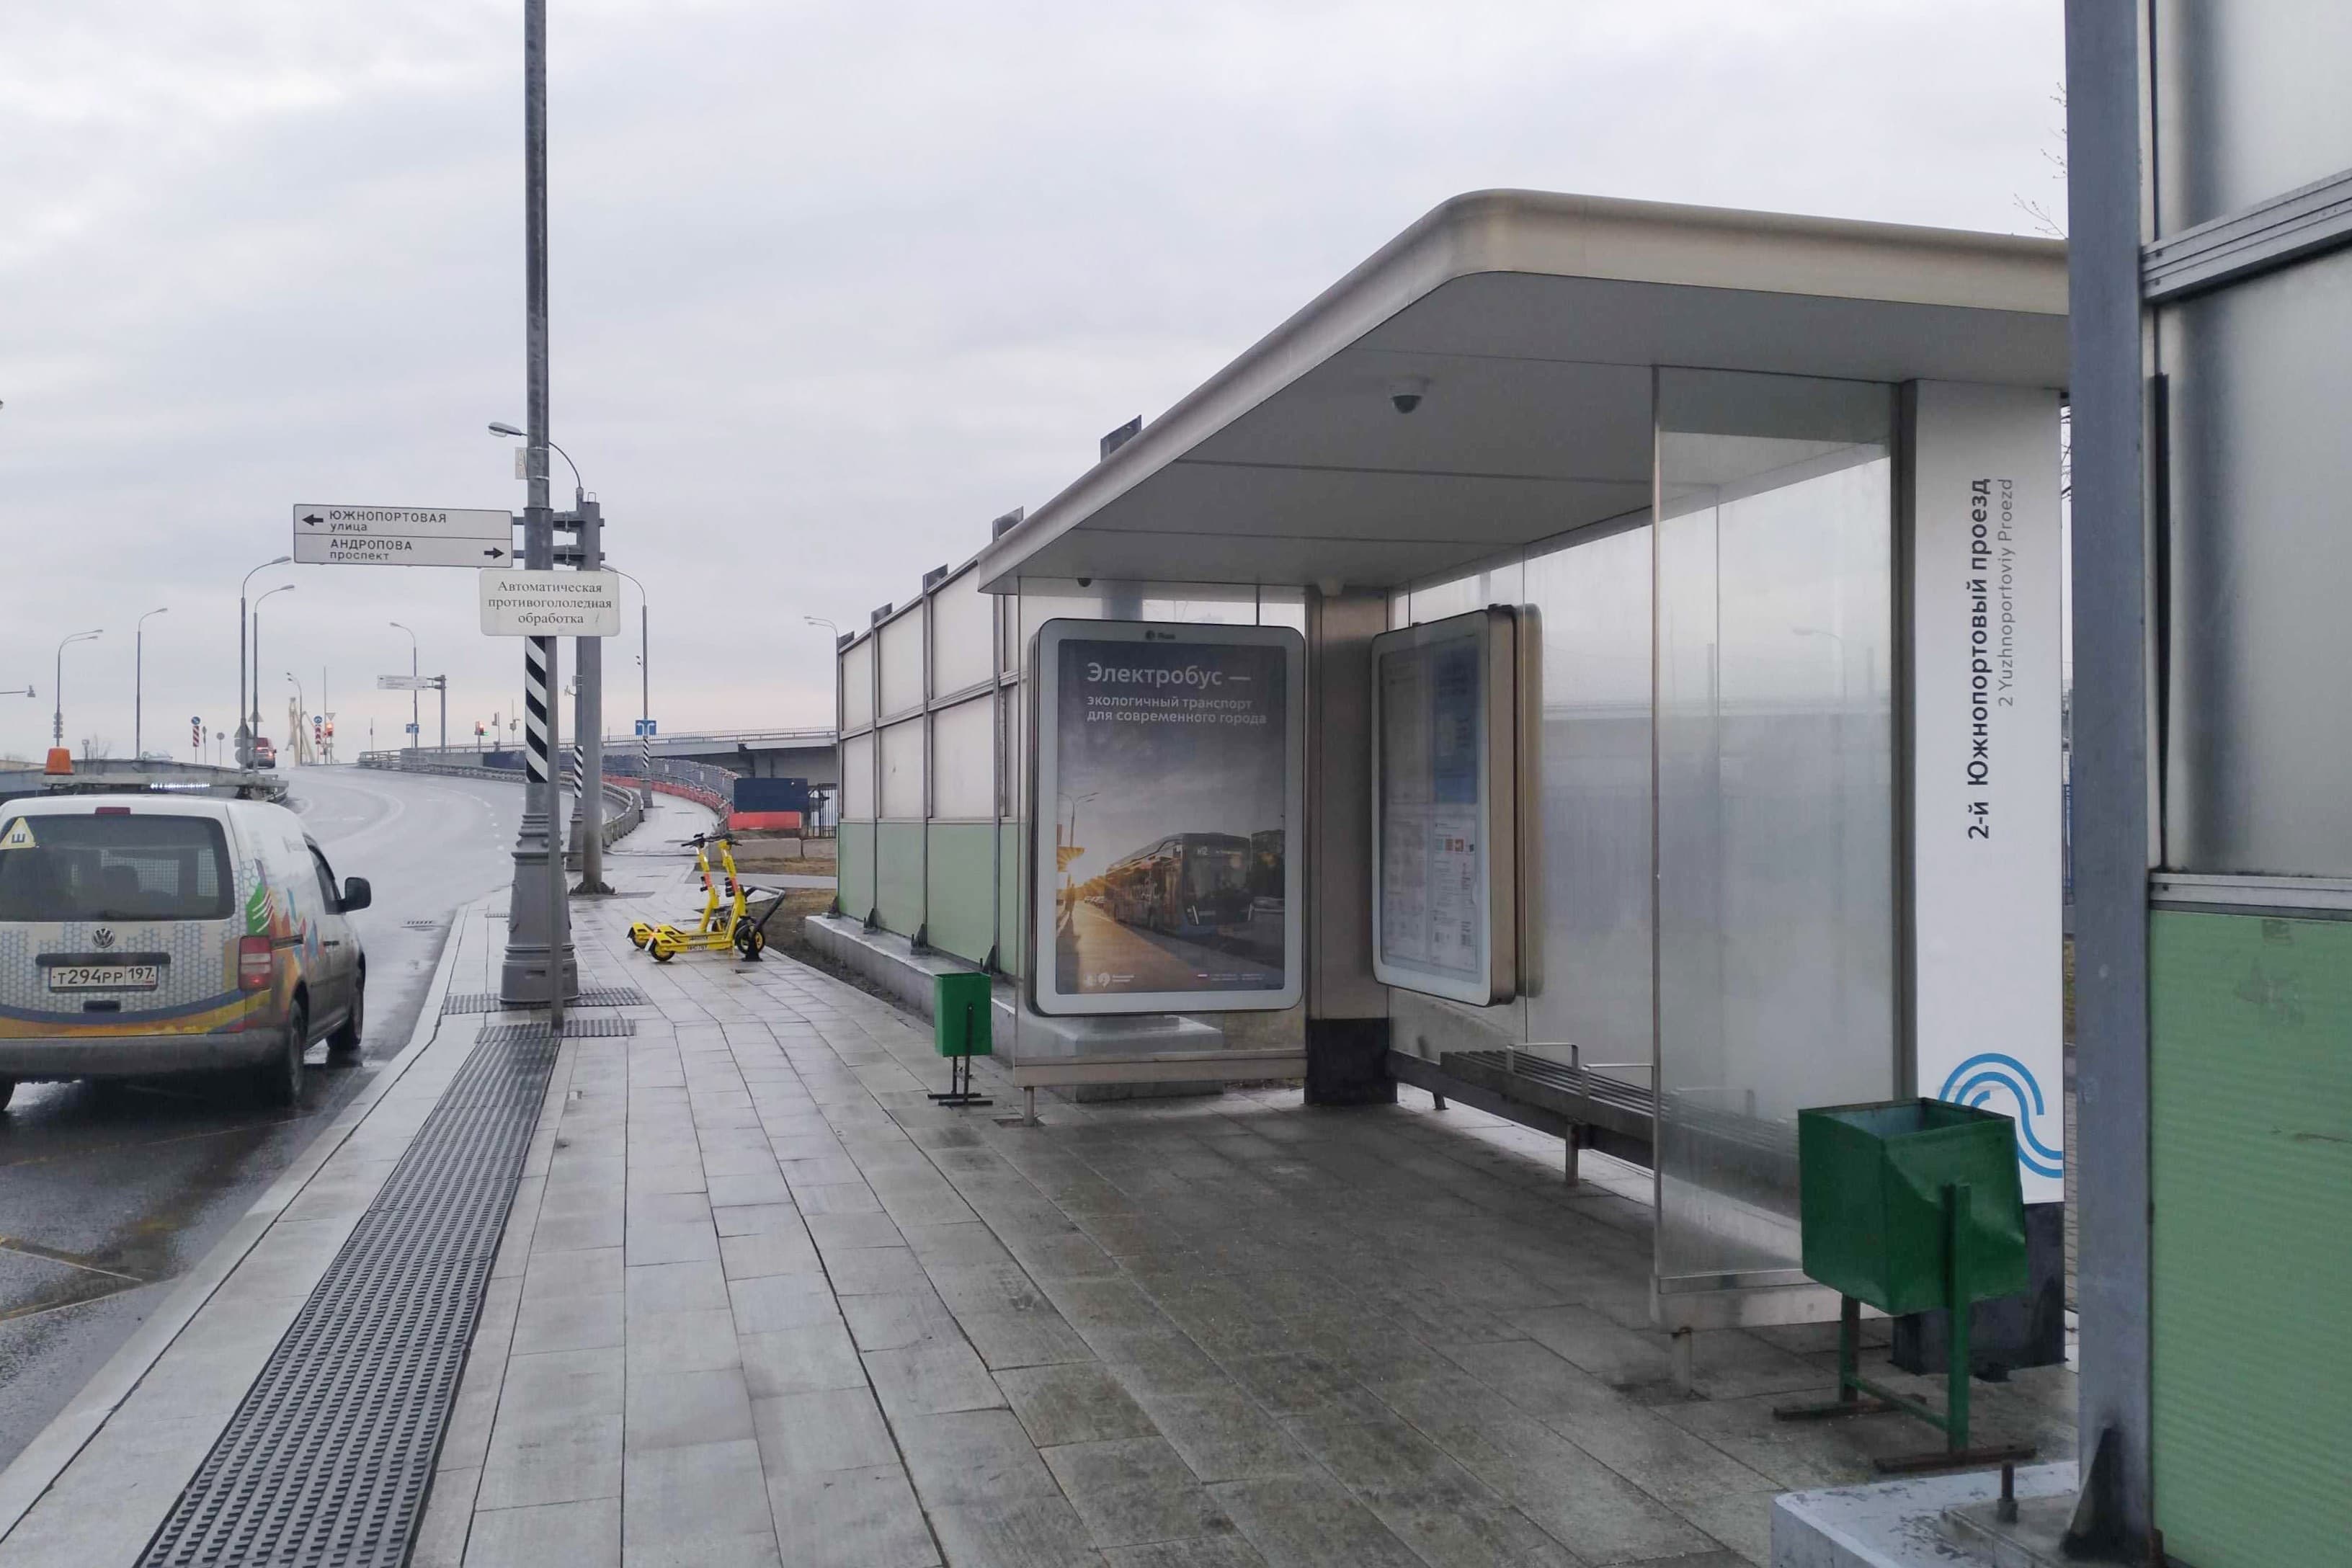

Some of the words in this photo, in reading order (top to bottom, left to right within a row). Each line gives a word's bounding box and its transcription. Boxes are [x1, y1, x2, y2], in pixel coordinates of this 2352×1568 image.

[329, 509, 447, 523] ЮЖНОПОРТОВАЯ
[1997, 478, 2013, 541] Proezd
[330, 522, 368, 532] улица
[1972, 478, 1992, 570] проезд
[330, 539, 413, 551] АНДРОПОВА
[330, 551, 390, 561] проспект
[497, 581, 602, 593] Автоматическая
[488, 598, 612, 610] противогололедная
[518, 612, 584, 626] обработка
[1997, 548, 2015, 691] Yuzhnoportoviy
[1087, 662, 1223, 690] Электробус
[1966, 579, 1992, 785] Южнопортовый
[1087, 695, 1180, 708] экологичный
[1182, 698, 1252, 710] транспорт
[1997, 696, 2013, 707] 2
[1087, 709, 1113, 723] для
[1117, 710, 1216, 724] современного
[1219, 713, 1268, 725] города
[1967, 802, 1990, 839] 2-й
[11, 833, 26, 844] Ш
[128, 967, 153, 979] 197
